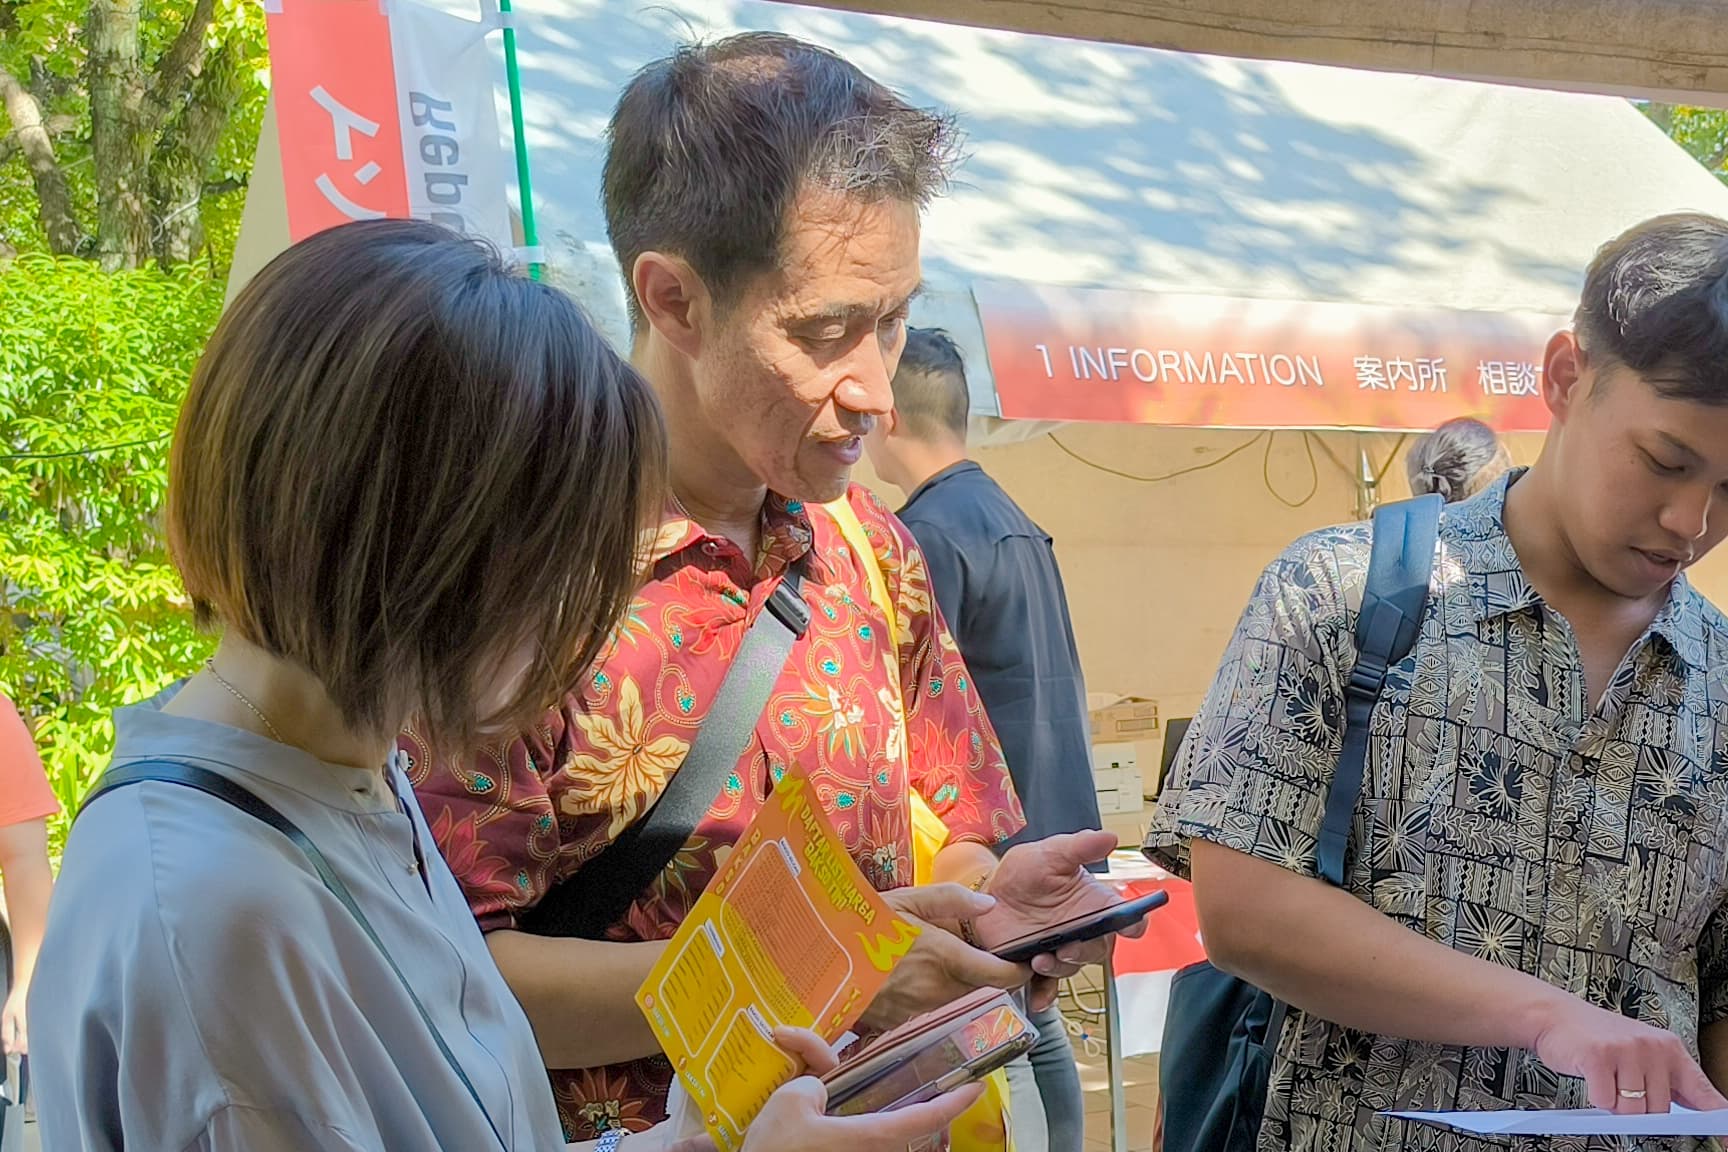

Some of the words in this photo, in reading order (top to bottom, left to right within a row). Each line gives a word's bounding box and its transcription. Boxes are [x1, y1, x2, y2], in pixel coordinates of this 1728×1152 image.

[1034, 343, 1055, 379] 1
[1067, 346, 1326, 388] INFORMATION
[1353, 354, 1448, 393] 案内所
[1476, 359, 1544, 397] 相談
[800, 804, 831, 856] DAFTAR
[827, 853, 846, 882] LIST
[843, 876, 877, 926] HARGA
